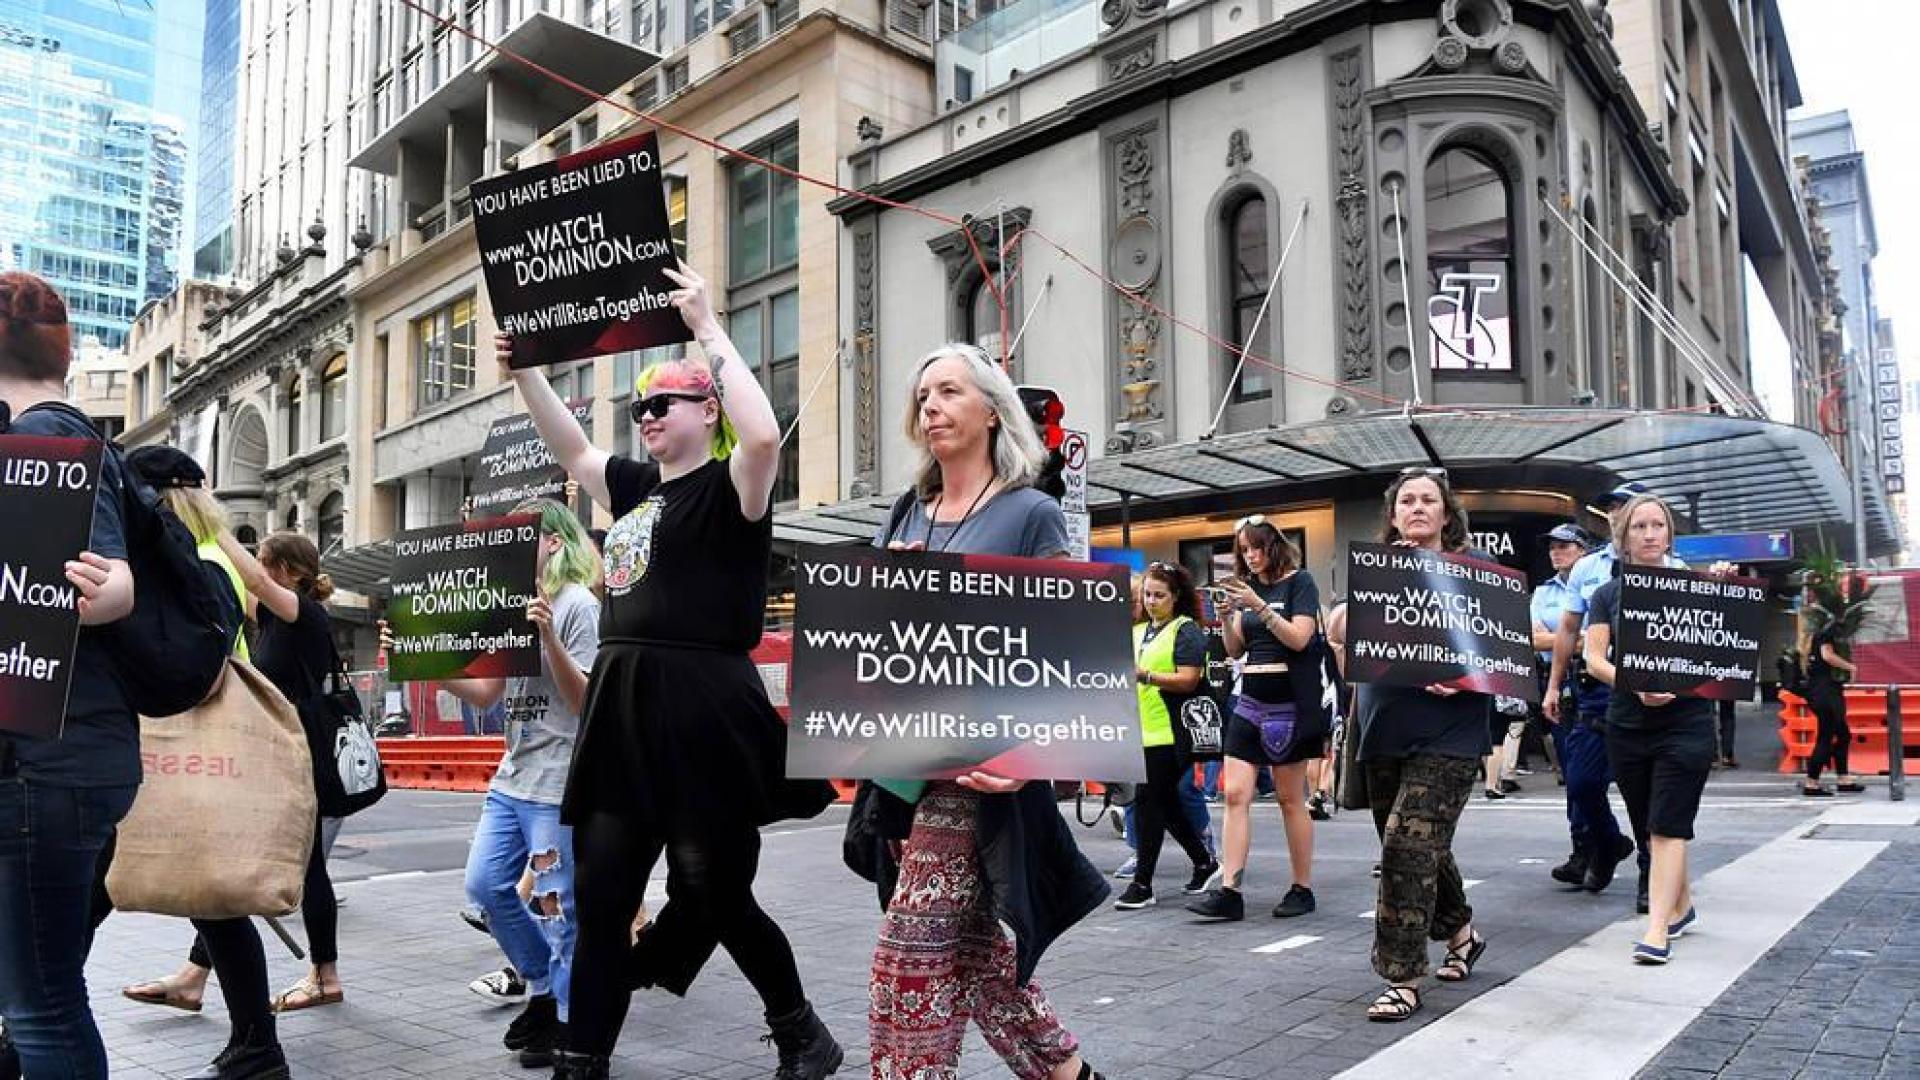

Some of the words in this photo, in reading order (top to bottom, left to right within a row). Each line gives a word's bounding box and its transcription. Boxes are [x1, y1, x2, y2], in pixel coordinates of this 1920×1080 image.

[475, 192, 507, 216] YOU
[510, 179, 548, 208] HAVE
[552, 168, 591, 196] BEEN
[594, 158, 625, 184] LIED
[628, 150, 657, 175] TO.
[515, 234, 670, 286] DOMINION.COM
[4, 458, 50, 487] LIED
[57, 461, 92, 490] TO.
[1066, 474, 1081, 487] NO
[396, 540, 420, 556] YOU
[422, 535, 453, 555] HAVE
[455, 531, 486, 550] BEEN
[488, 528, 513, 546] LIED
[517, 526, 537, 542] TO.
[1466, 530, 1515, 556] TRA
[803, 562, 862, 588] YOU
[872, 566, 941, 593] HAVE
[950, 571, 1014, 598] BEEN
[1023, 577, 1075, 600] LIED
[1082, 580, 1125, 603] TO.
[1351, 551, 1387, 567] YOU
[1391, 555, 1435, 573] HAVE
[1436, 561, 1471, 579] BEEN
[1475, 569, 1502, 587] LIED
[1504, 577, 1527, 594] TO.
[1624, 573, 1651, 588] YOU
[1655, 577, 1688, 592] HAVE
[1690, 581, 1721, 595] BEEN
[1723, 585, 1746, 598] LIED
[1748, 587, 1766, 601] TO.
[393, 628, 534, 655] #WeWillRiseTogether
[1384, 605, 1531, 647] DOMINION.COM
[1646, 622, 1758, 651] DOMINION.COM
[856, 652, 1128, 690] DOMINION.COM
[1355, 640, 1531, 678] #WeWillRiseTogether
[1622, 652, 1754, 682] #WeWillRiseTogether
[804, 711, 1128, 746] #WeWillRiseTogether
